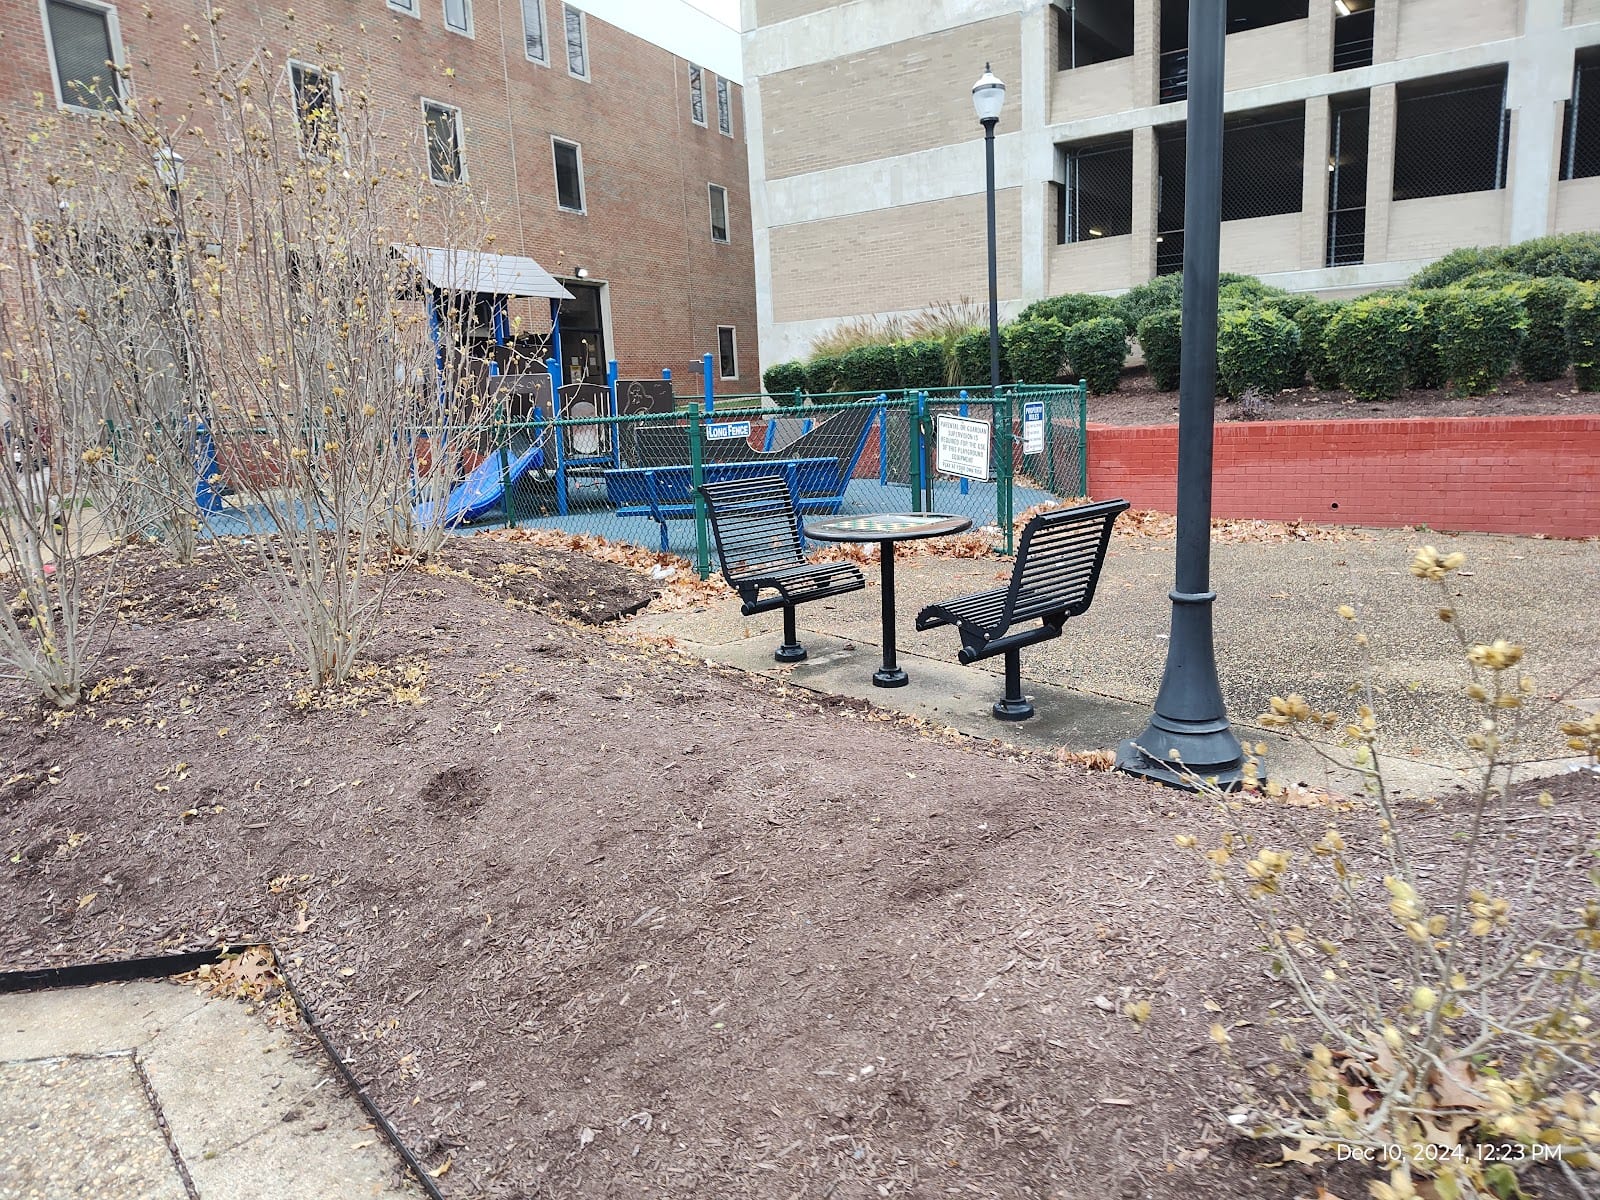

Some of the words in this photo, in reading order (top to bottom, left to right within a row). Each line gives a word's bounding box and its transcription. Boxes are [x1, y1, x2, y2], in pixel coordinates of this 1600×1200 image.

[709, 426, 728, 438] LONG
[728, 424, 749, 436] FENCE
[940, 421, 959, 430] PARENTAL
[967, 425, 987, 435] GUARDIAN
[948, 430, 973, 440] SUPERVISION
[941, 436, 960, 446] REQUIRED
[960, 439, 969, 447] FOR
[969, 441, 977, 449] THE
[951, 453, 974, 463] EQUIPMENT
[957, 446, 984, 458] PLAYGROUND
